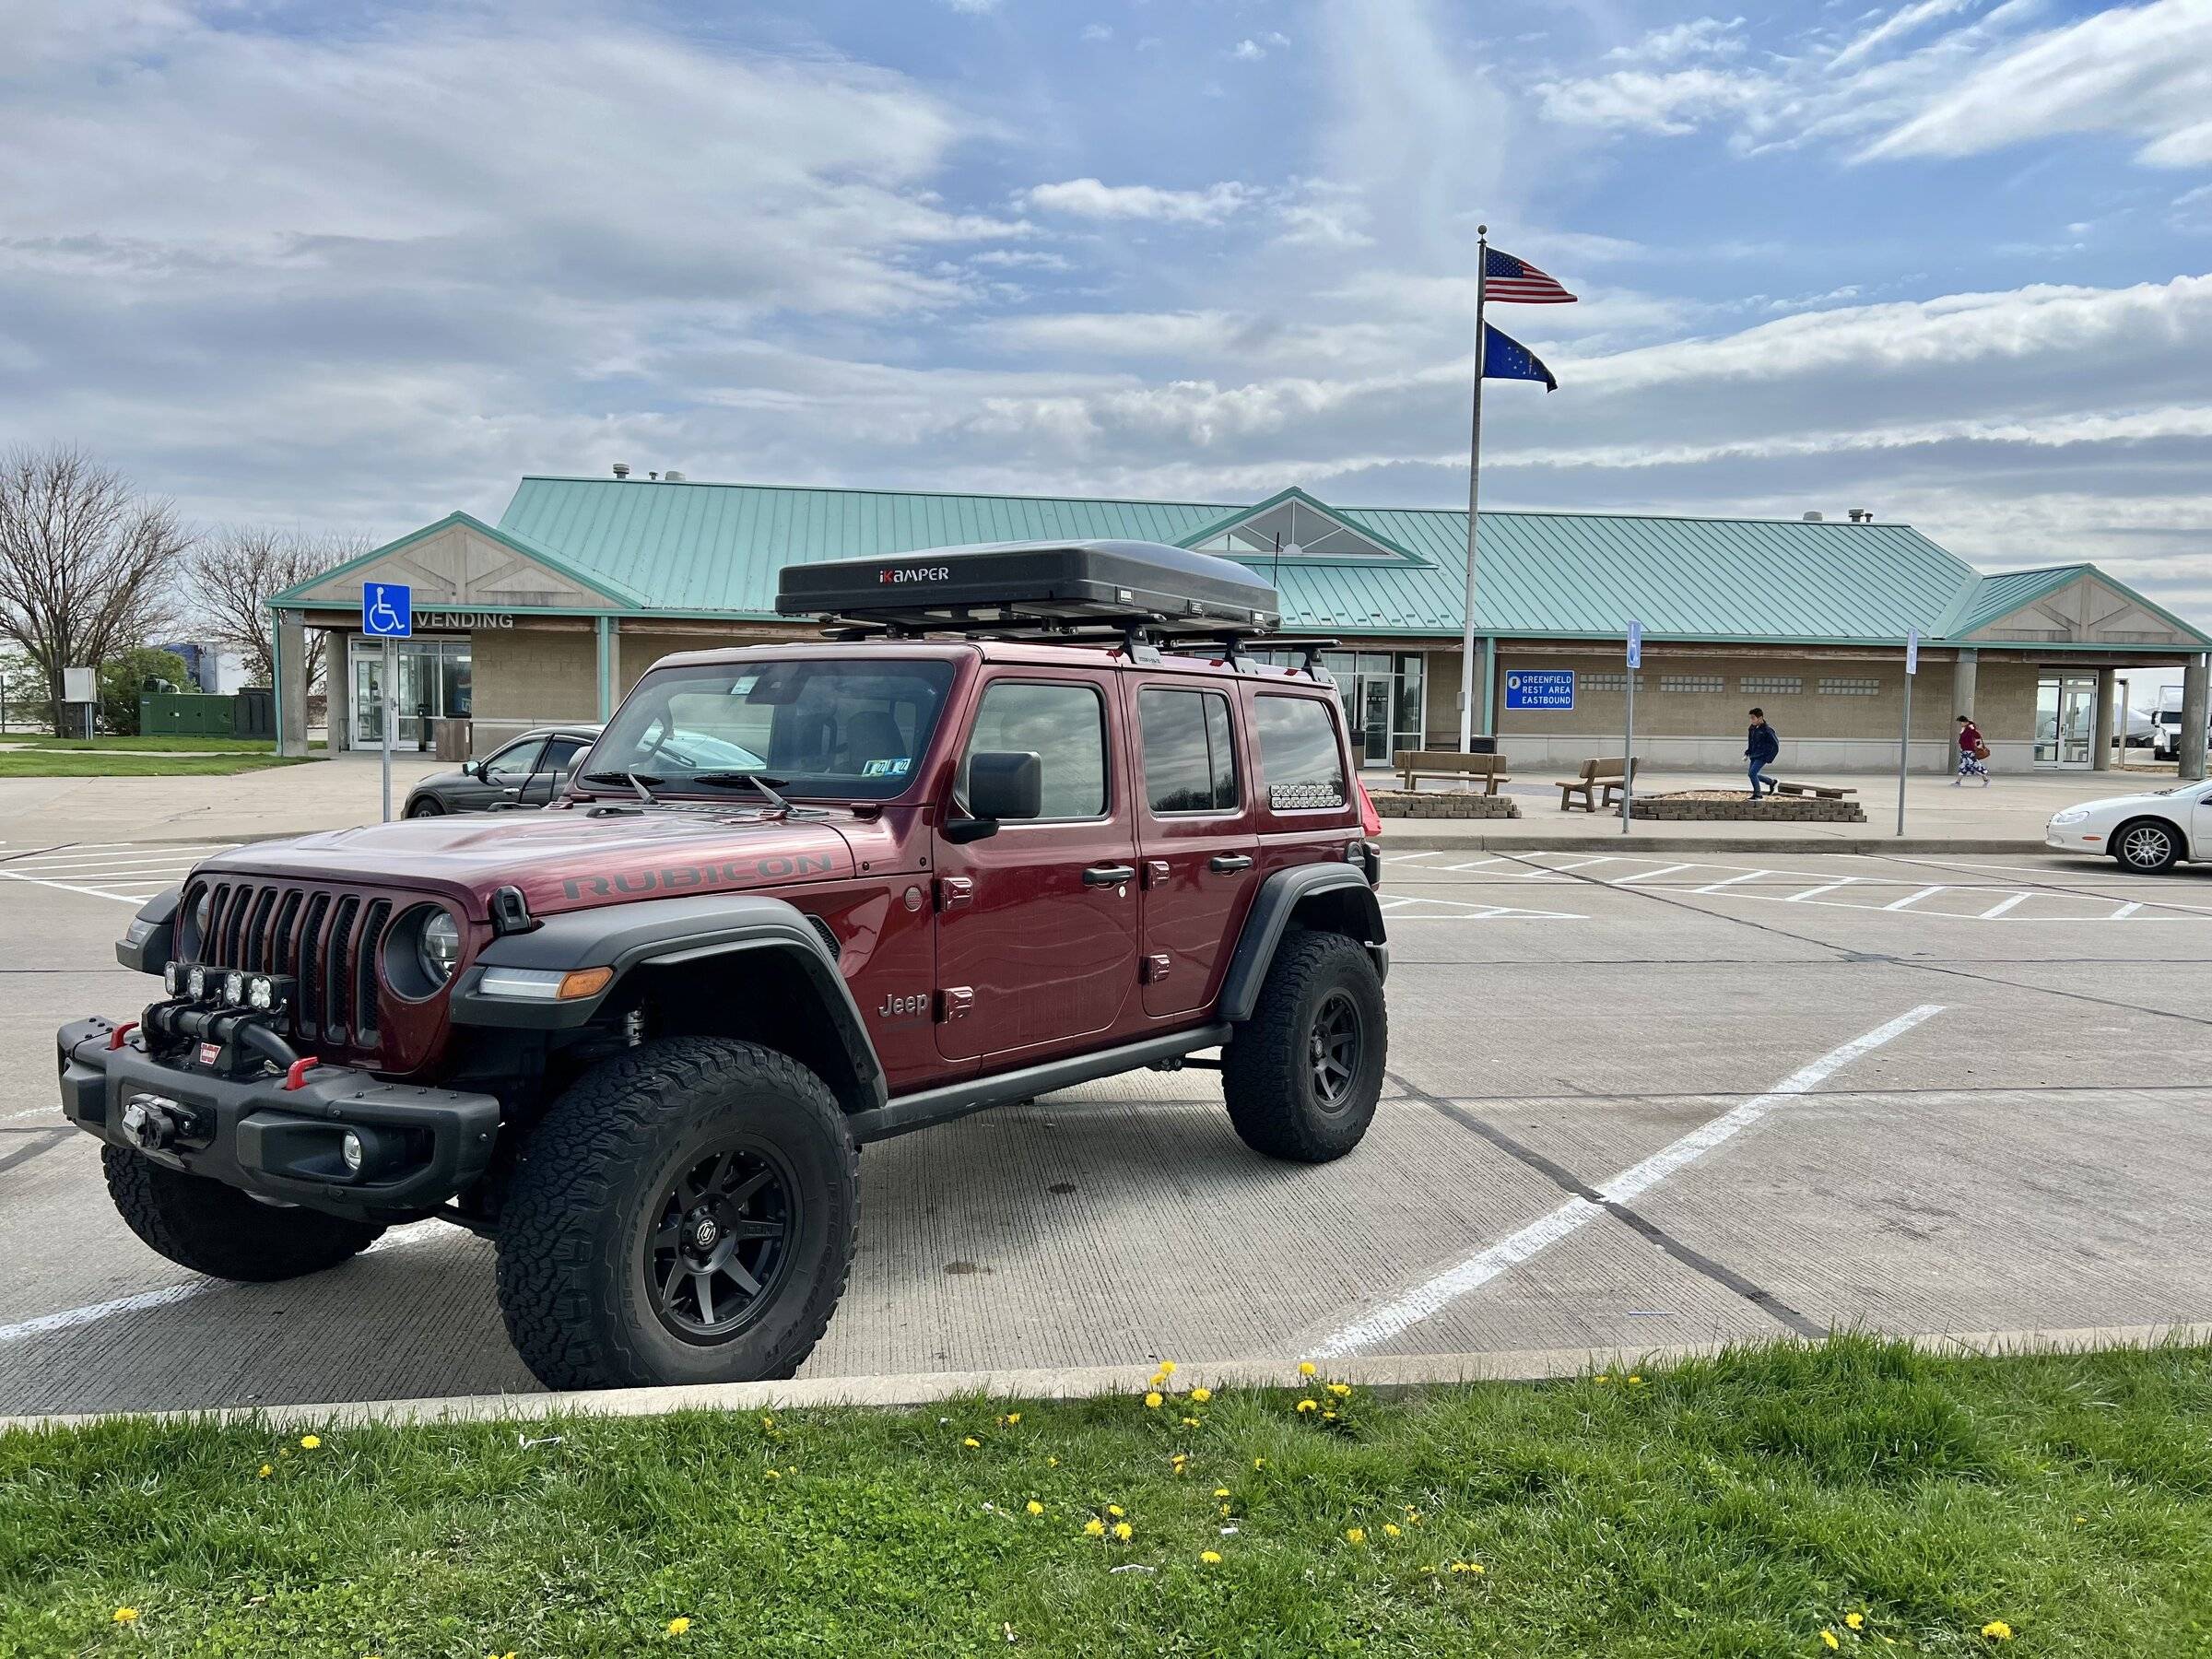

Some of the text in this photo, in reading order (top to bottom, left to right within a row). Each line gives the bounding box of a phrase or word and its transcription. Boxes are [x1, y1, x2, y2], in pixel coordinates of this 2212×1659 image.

[417, 612, 513, 629] VENDING
[1522, 675, 1572, 684] GREENFIELD
[1522, 686, 1571, 694] REST AREA
[1522, 696, 1571, 704] EASTBOUND
[562, 853, 833, 900] RUBICON
[877, 994, 928, 1018] Jeep
